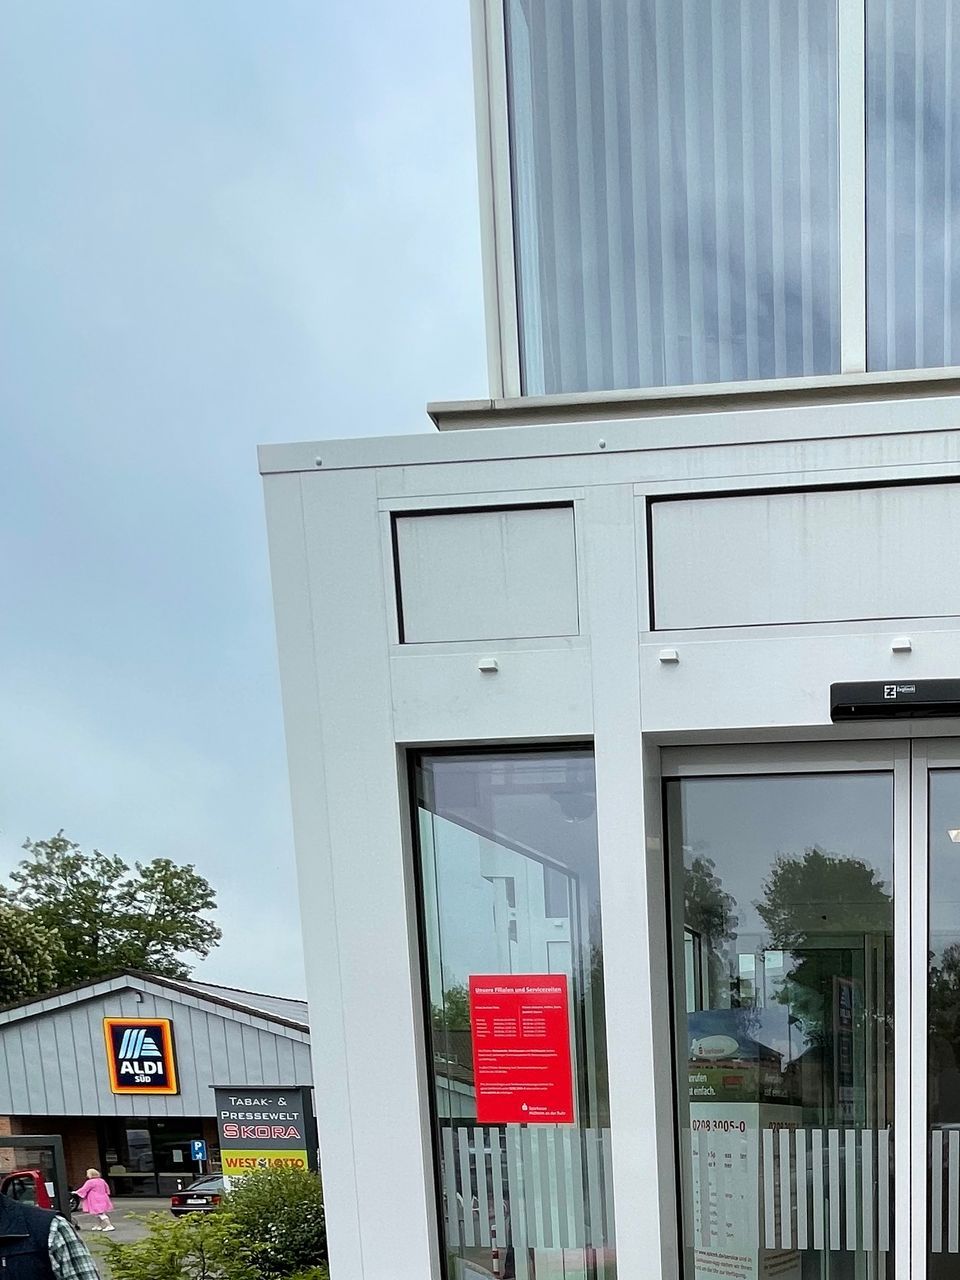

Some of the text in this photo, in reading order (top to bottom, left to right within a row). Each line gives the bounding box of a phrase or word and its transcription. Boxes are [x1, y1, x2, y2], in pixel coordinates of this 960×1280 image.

[120, 1061, 163, 1074] ALDI
[135, 1074, 151, 1082] SÜD
[689, 1073, 707, 1082] nrufen
[229, 1097, 287, 1106] TABAK- &
[221, 1111, 299, 1120] PRESSEWELT
[223, 1123, 301, 1139] SKORA
[194, 1141, 202, 1150] P
[226, 1158, 257, 1168] WEST
